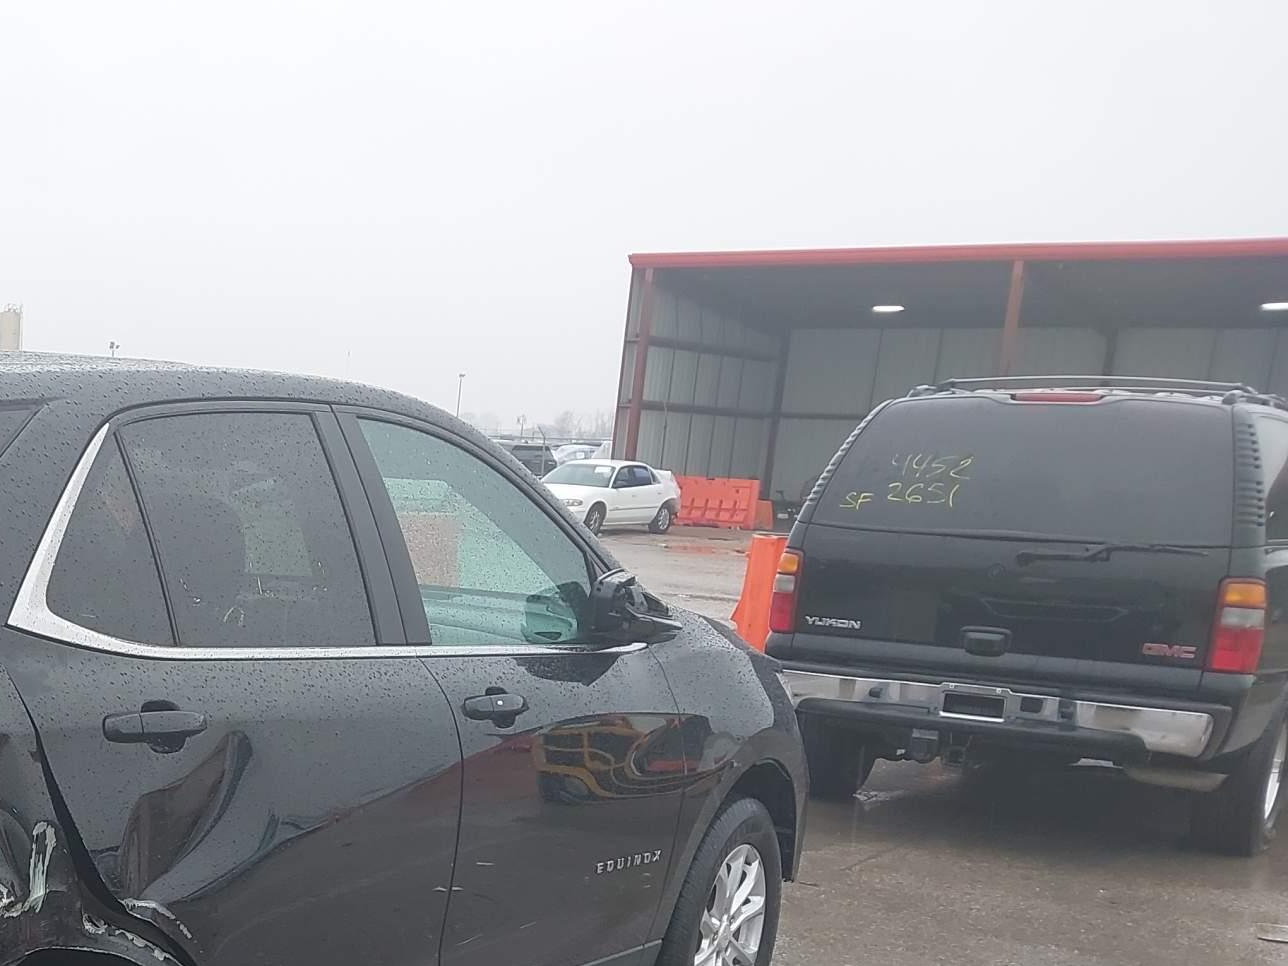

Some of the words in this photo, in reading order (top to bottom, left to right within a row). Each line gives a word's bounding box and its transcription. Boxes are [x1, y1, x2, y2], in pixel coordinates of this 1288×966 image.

[839, 491, 874, 510] SF
[887, 482, 960, 508] 2651
[805, 615, 861, 629] YUKON
[1142, 642, 1197, 658] GMC
[596, 849, 662, 874] EQUINOX
